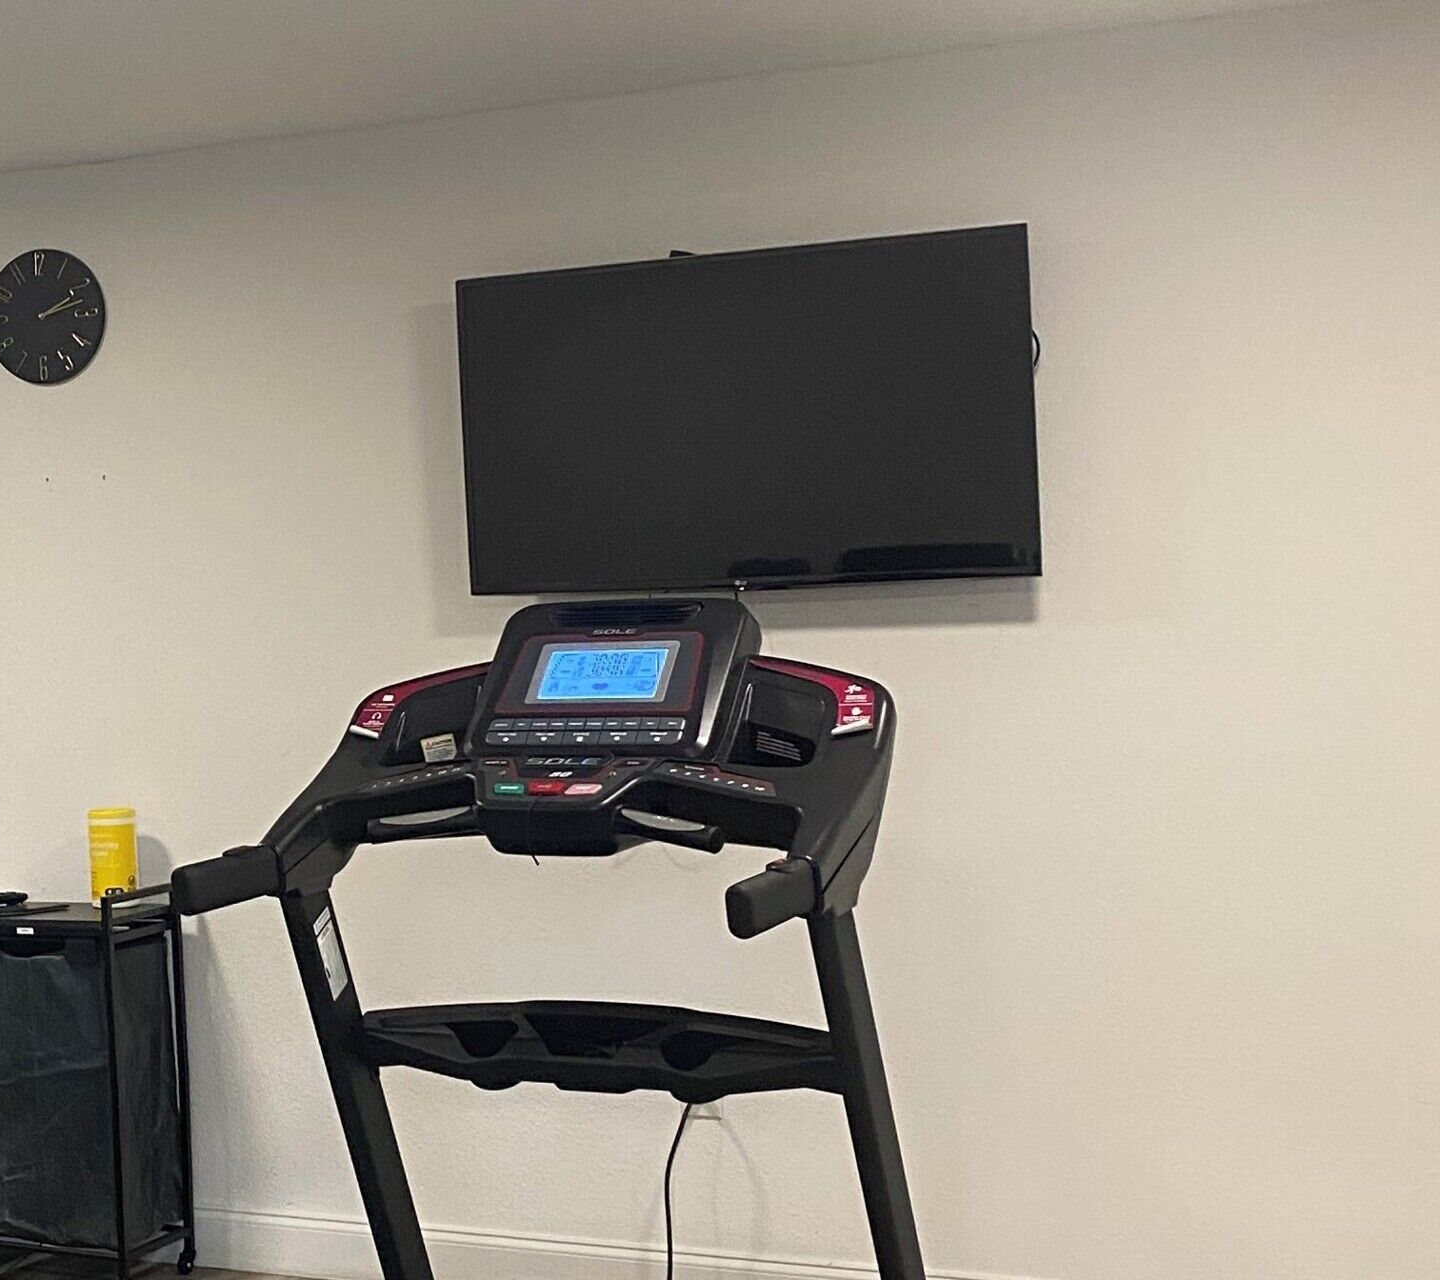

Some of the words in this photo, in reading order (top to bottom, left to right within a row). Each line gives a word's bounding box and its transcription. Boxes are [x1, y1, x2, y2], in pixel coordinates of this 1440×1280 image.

[33, 251, 45, 277] 12
[68, 277, 91, 297] 2
[74, 307, 98, 319] 3
[39, 354, 49, 381] 6
[592, 628, 638, 636] SOLE
[524, 757, 602, 766] SOLE
